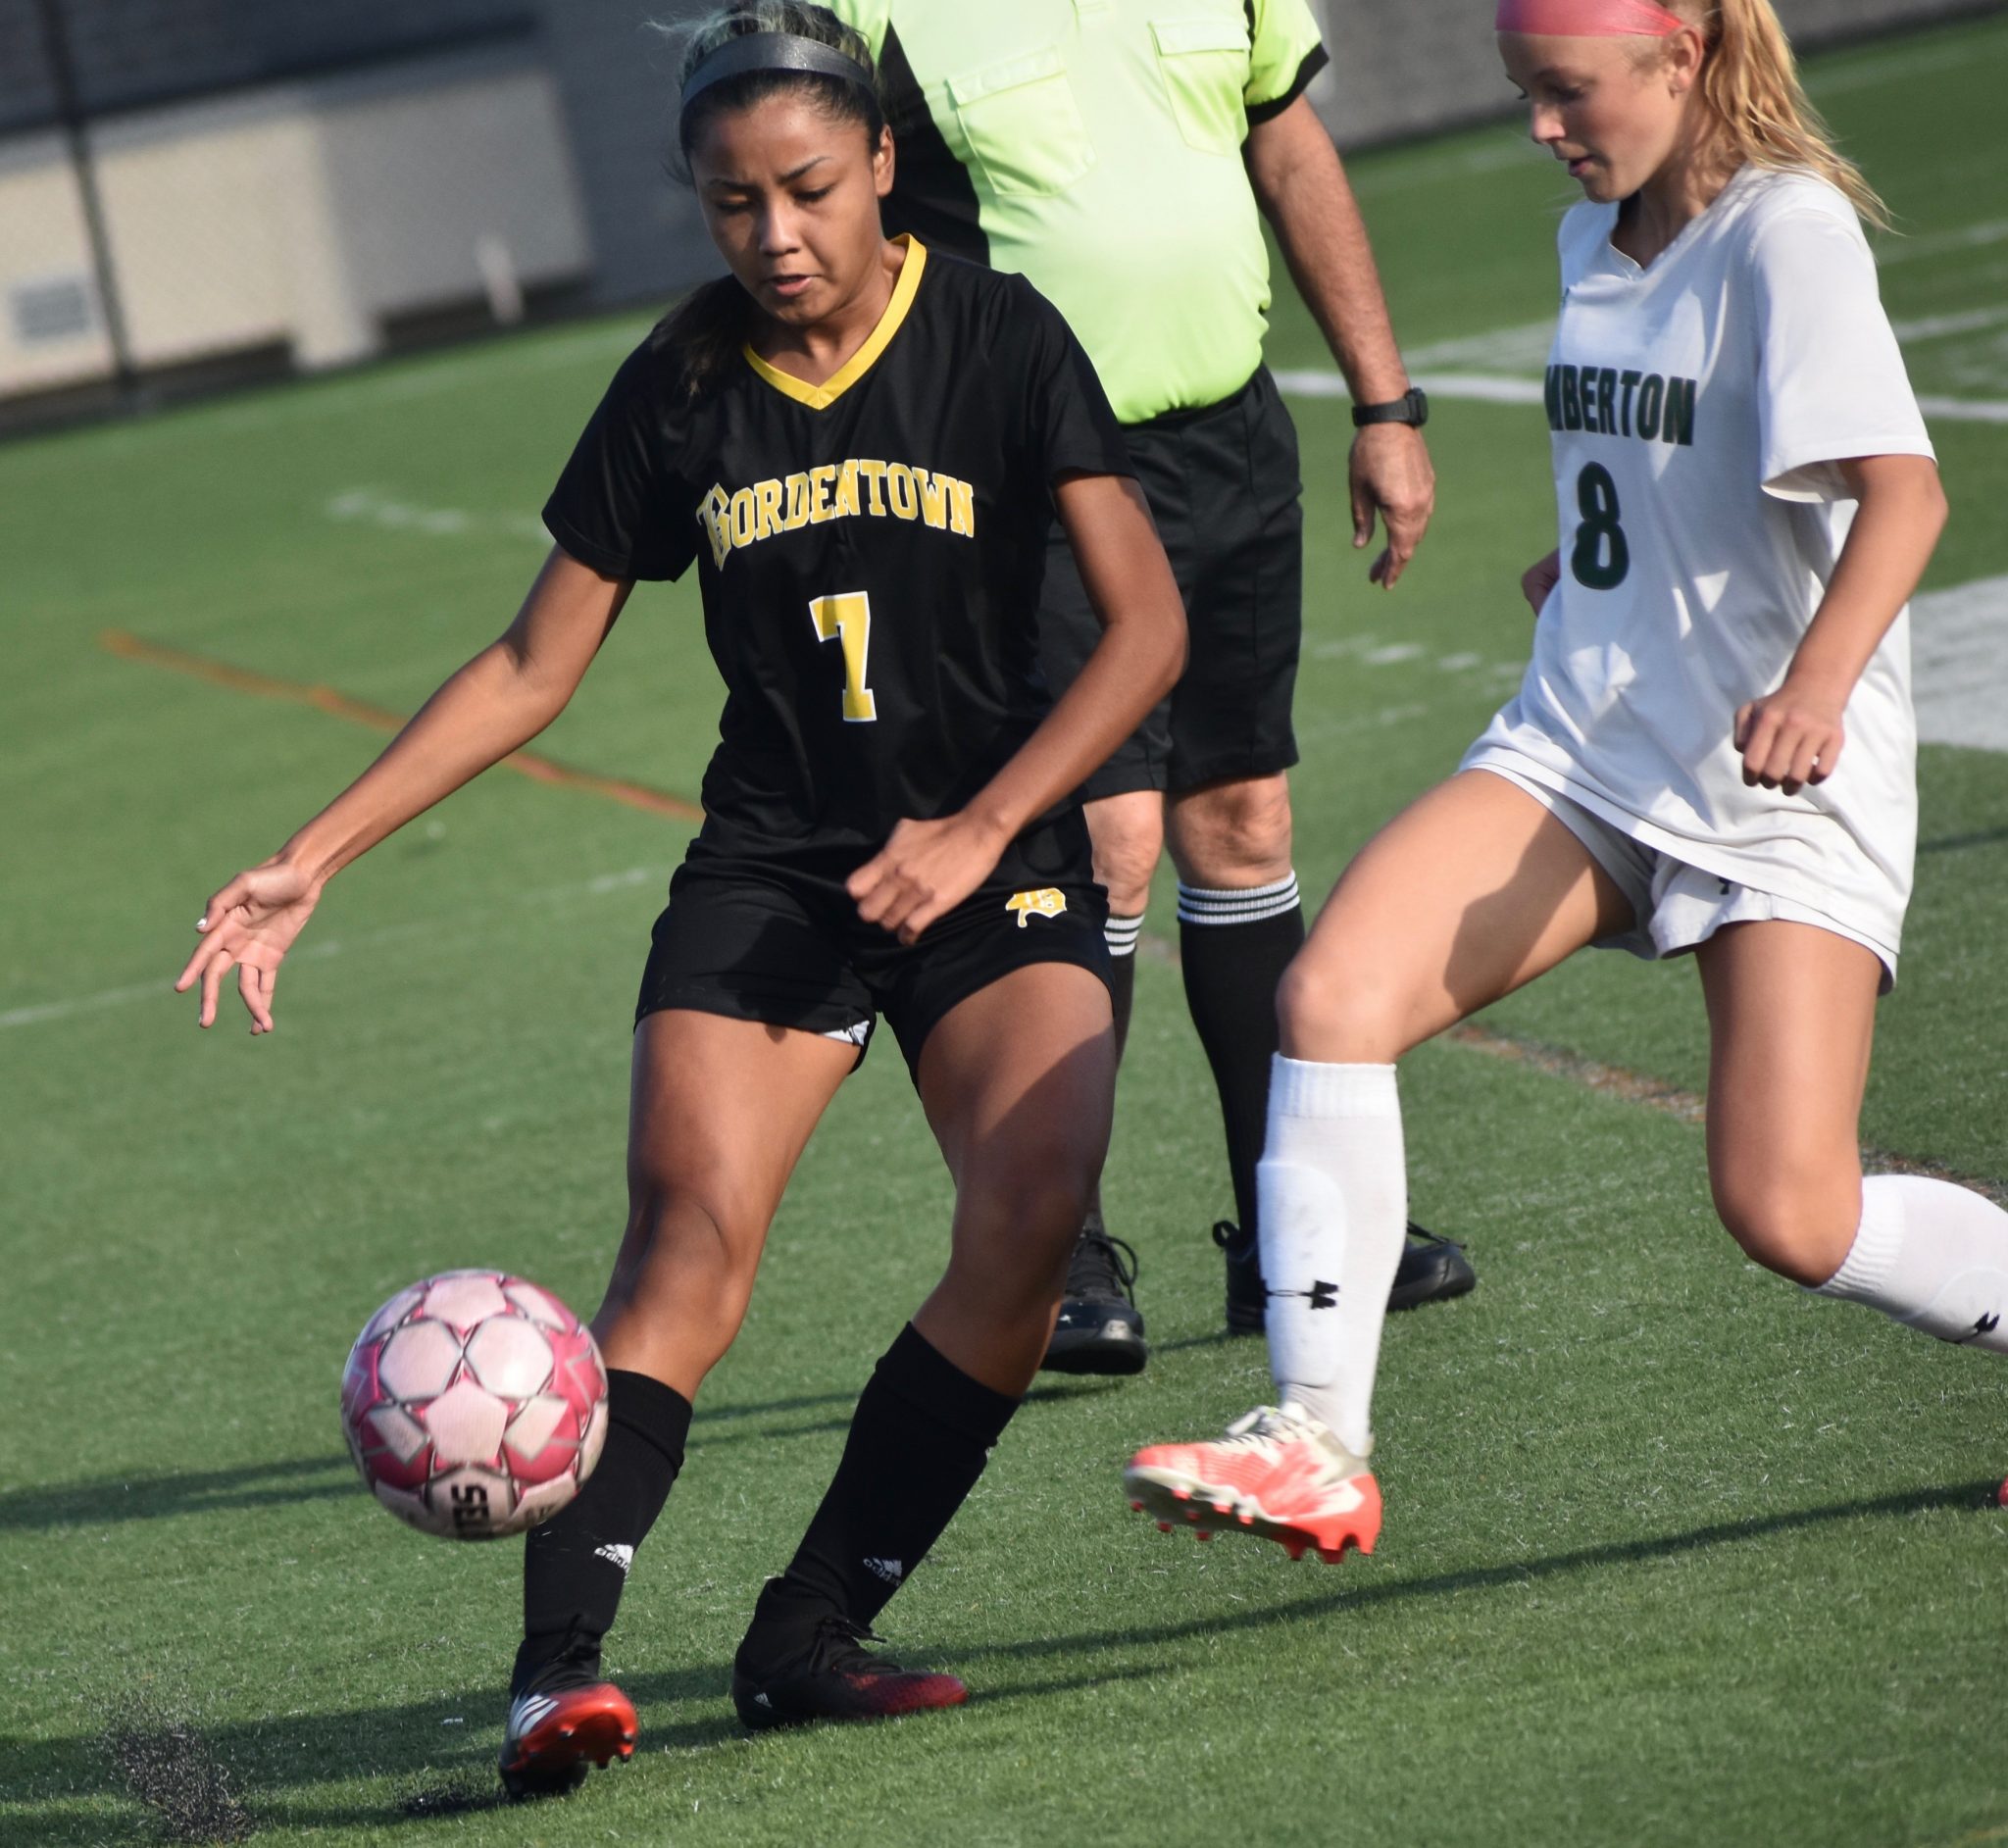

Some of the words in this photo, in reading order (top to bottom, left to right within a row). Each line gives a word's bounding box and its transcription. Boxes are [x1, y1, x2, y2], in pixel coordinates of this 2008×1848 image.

[695, 458, 975, 572] BORDENTOWN
[1571, 461, 1630, 590] 8
[808, 590, 878, 723] 7
